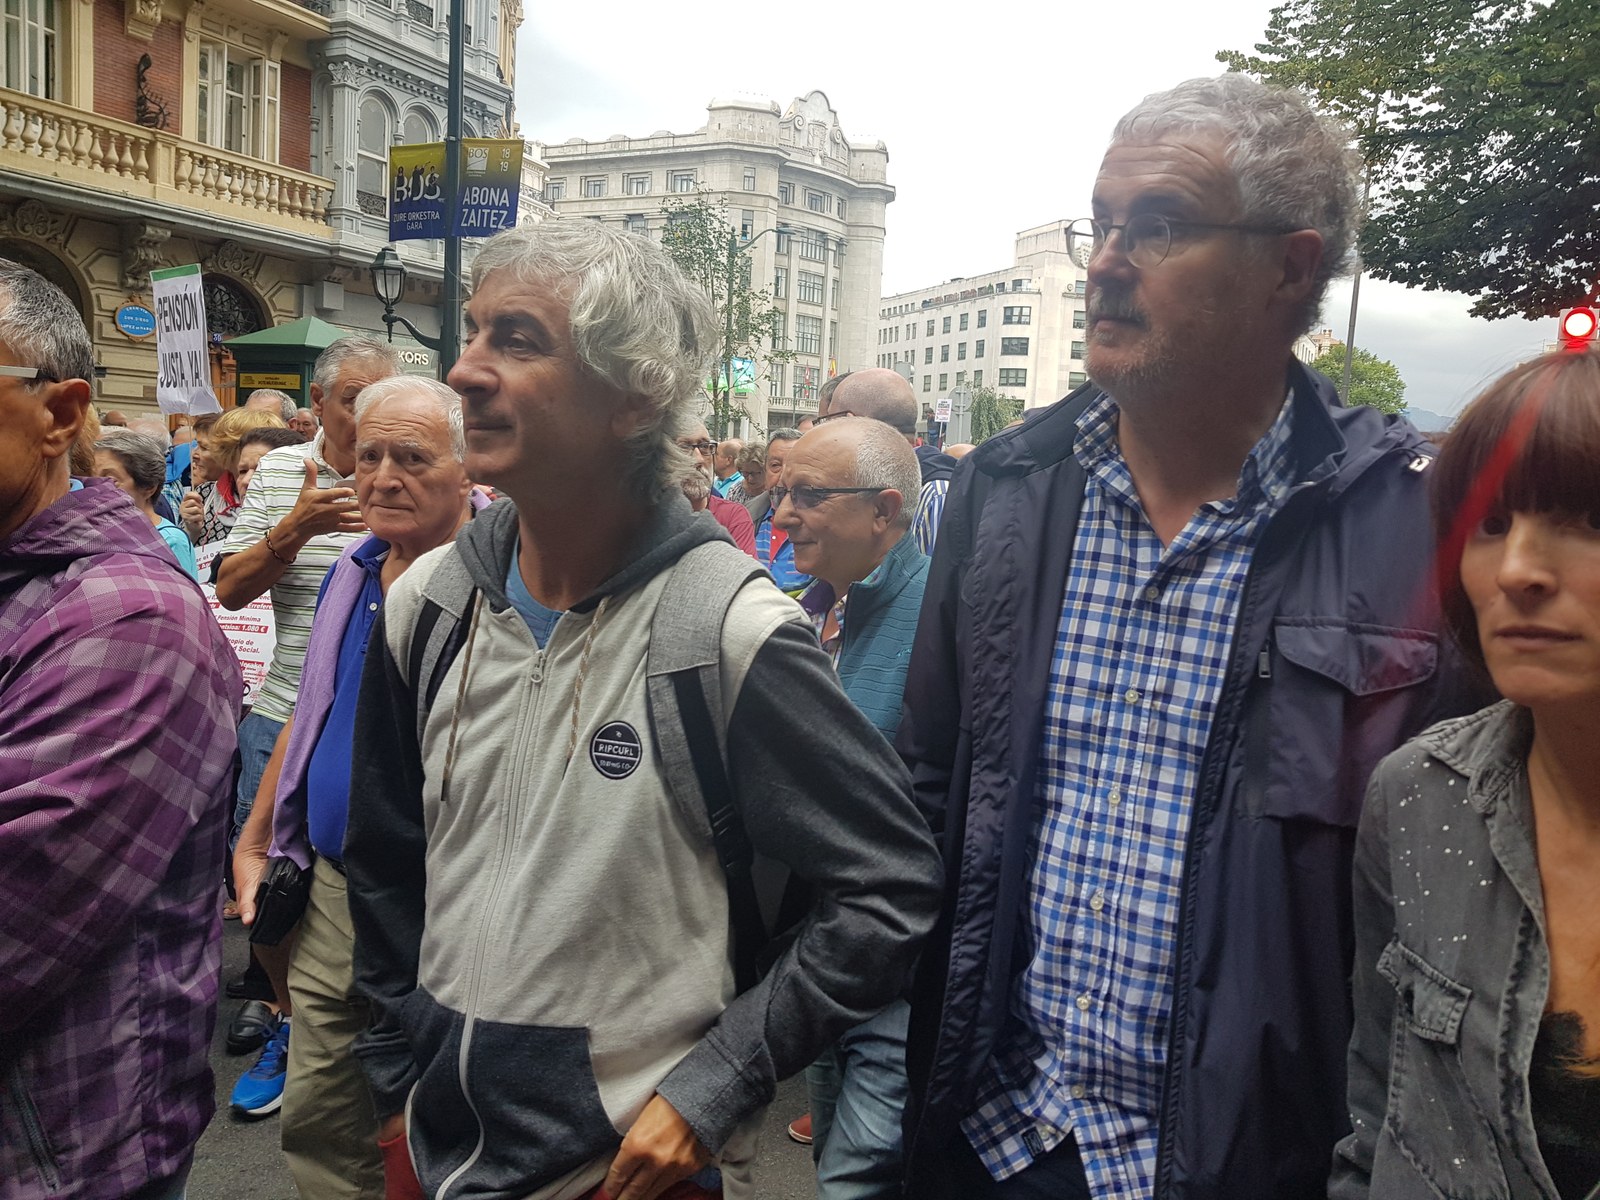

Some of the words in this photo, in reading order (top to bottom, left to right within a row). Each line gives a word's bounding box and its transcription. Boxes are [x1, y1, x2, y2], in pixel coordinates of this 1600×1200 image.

[469, 148, 488, 158] BOS
[502, 148, 511, 159] 18
[500, 161, 509, 172] 19
[394, 173, 441, 203] BOS
[462, 187, 510, 207] ABONA
[393, 212, 407, 223] ZURE
[408, 211, 441, 220] ORKESTRA
[461, 208, 508, 229] ZAITEZ
[406, 221, 423, 230] GARA
[398, 350, 429, 365] KORS
[187, 350, 203, 387] YA!
[238, 645, 260, 654] Social.
